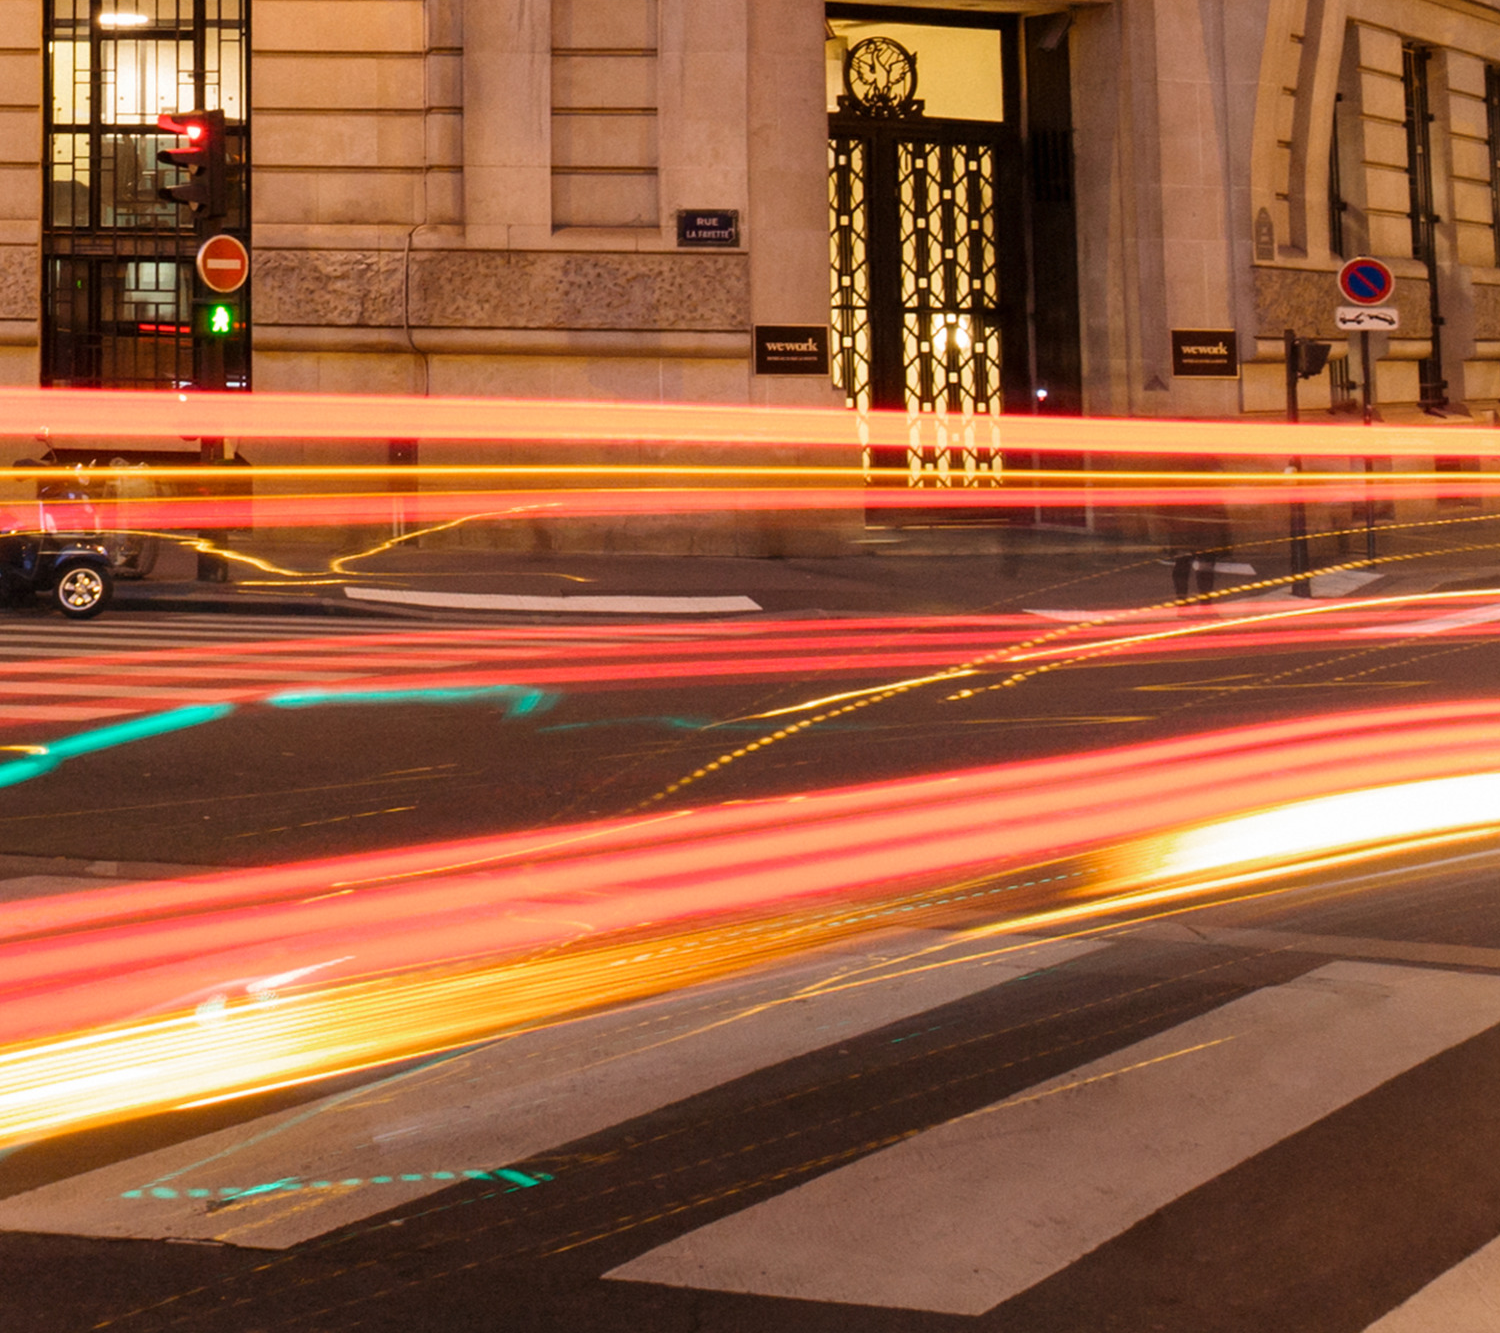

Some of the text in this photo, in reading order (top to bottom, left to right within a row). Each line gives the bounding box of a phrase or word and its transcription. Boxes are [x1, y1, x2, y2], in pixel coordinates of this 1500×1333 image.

[696, 217, 719, 226] RUE
[686, 230, 729, 239] LA FAYETTE
[765, 337, 818, 351] wework
[1181, 341, 1228, 355] wework
